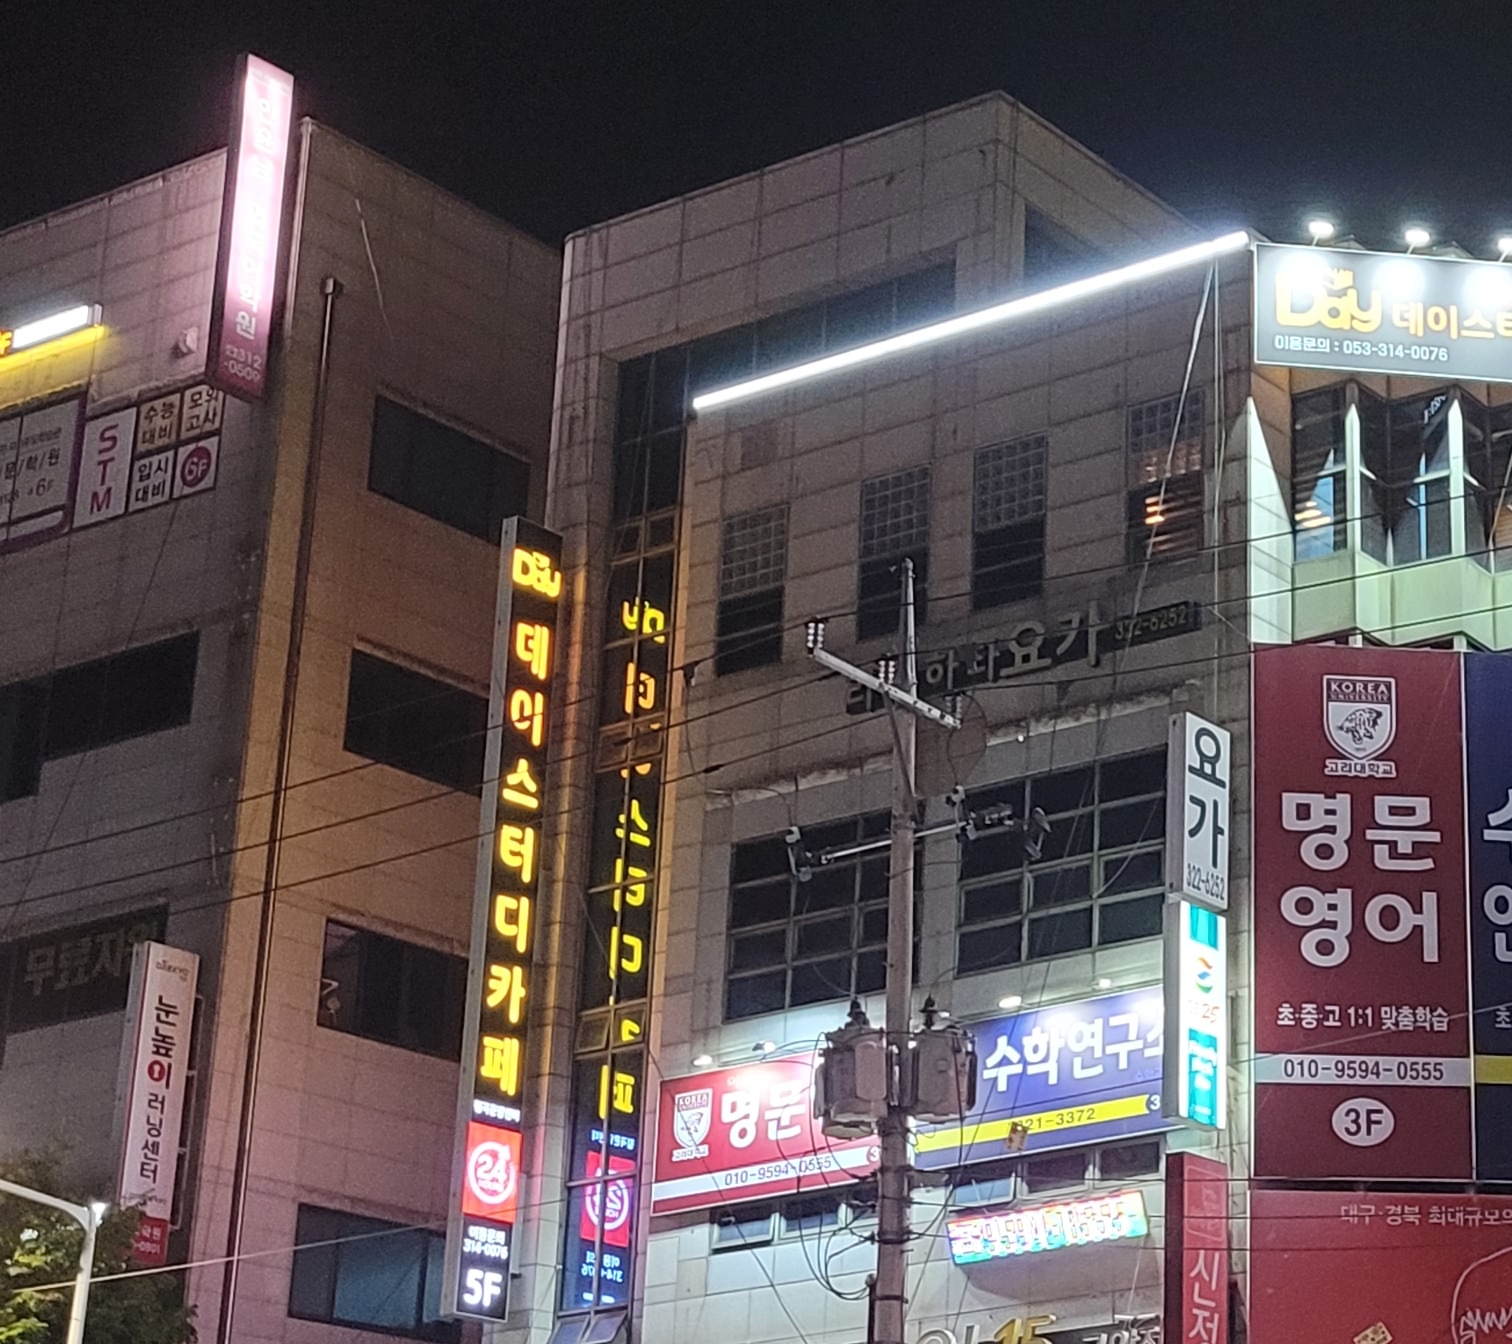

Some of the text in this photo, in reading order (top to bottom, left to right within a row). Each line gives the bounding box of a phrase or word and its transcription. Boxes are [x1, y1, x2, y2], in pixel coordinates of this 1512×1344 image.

[1274, 335, 1331, 354] 이용문의
[1343, 340, 1449, 362] 053-314-0076
[143, 402, 176, 420] 수능
[185, 411, 218, 432] 고사
[141, 424, 173, 445] 대비
[137, 457, 169, 481] 입시
[183, 457, 209, 481] 6F
[134, 480, 167, 504] 대비
[1328, 679, 1390, 697] KOREA
[1187, 725, 1227, 870] 요가
[1281, 792, 1442, 872] 명문
[480, 621, 550, 1097] 데이스터디카페
[1185, 862, 1227, 902] 322-6252
[1280, 886, 1440, 968] 영어
[1347, 1006, 1375, 1029] 1:1
[1380, 1005, 1450, 1034] 맞춤학습
[147, 994, 181, 1091] 눈높이
[1282, 1058, 1445, 1082] 010-9594-0555
[677, 1092, 710, 1107] KOREA
[720, 1078, 804, 1150] 명문
[1342, 1106, 1384, 1137] 3F
[139, 1092, 166, 1184] 러닝센터
[475, 1152, 508, 1182] 24
[723, 1157, 833, 1188] 010-9594-0555
[462, 1268, 503, 1308] 5F
